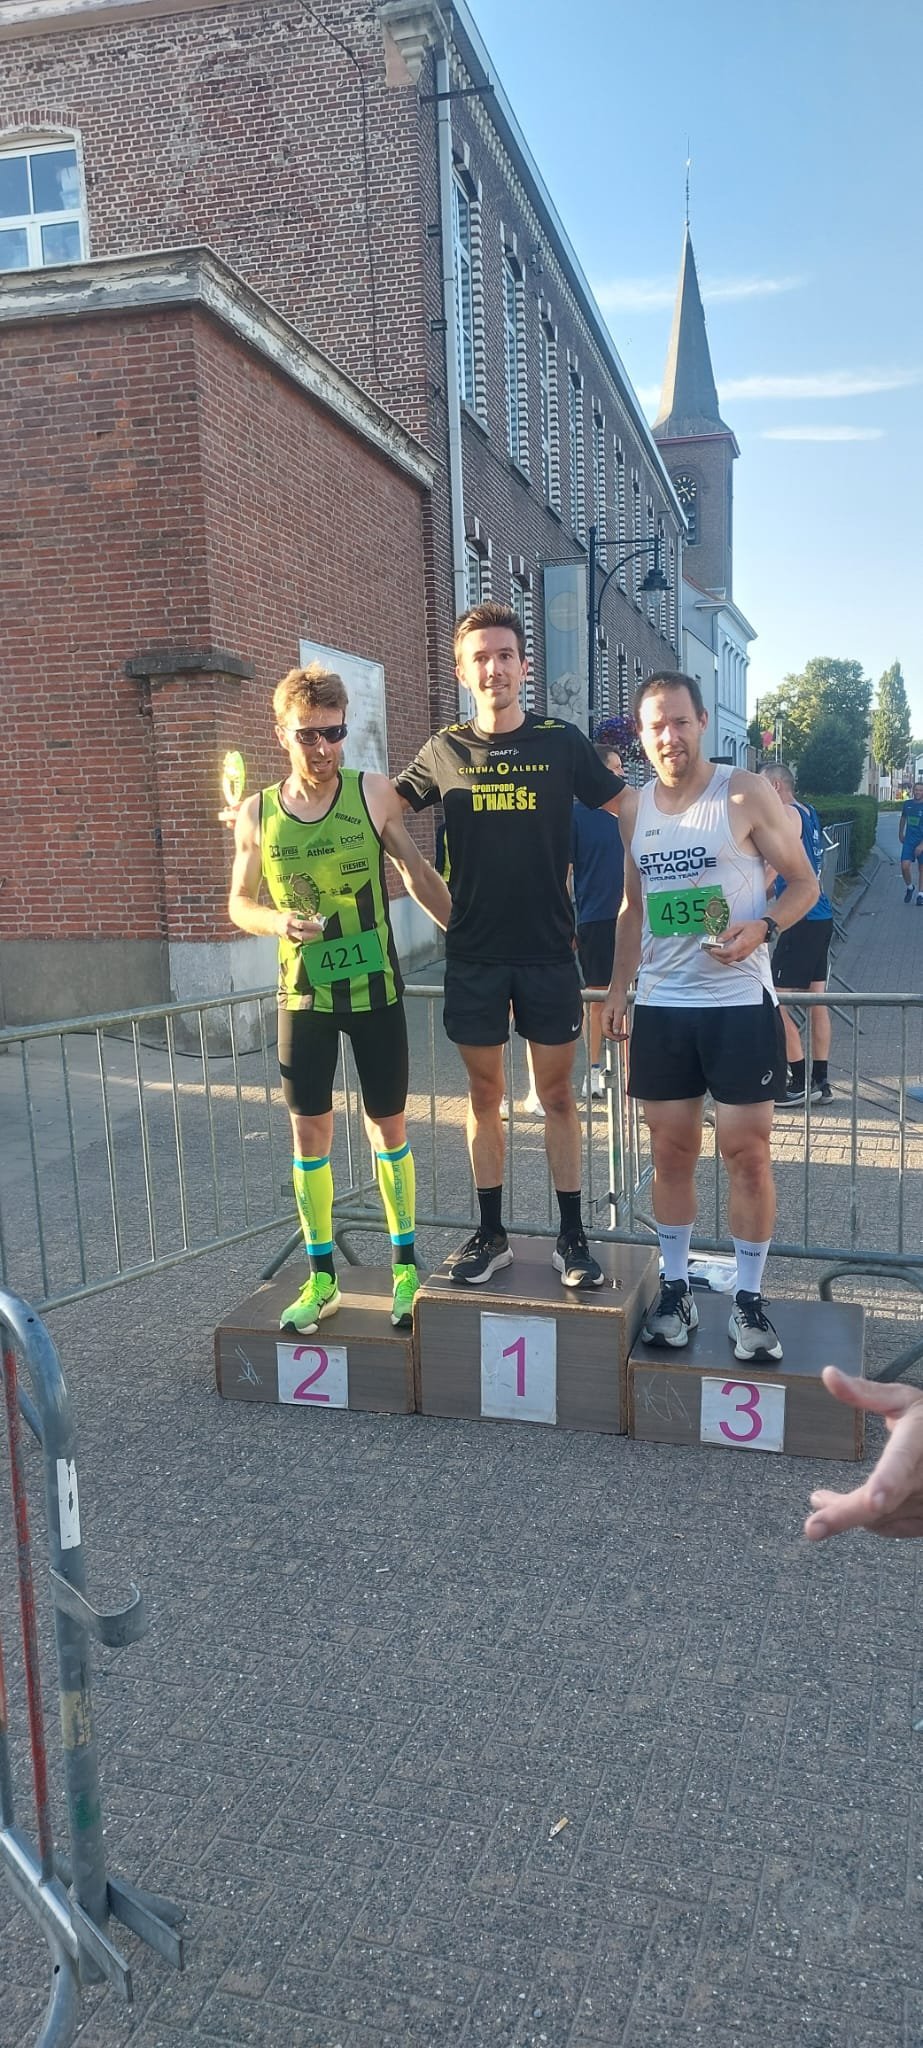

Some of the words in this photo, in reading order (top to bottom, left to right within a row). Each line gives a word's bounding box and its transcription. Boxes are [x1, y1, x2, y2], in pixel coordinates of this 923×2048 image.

[489, 749, 513, 757] CRAFT
[458, 765, 495, 775] CINEMA
[511, 764, 550, 772] ALBERT
[471, 782, 515, 793] SPORTPODO
[306, 846, 336, 858] Athlex
[640, 847, 706, 865] STUDIO
[649, 874, 676, 882] CYCLING
[677, 871, 699, 880] TEAM
[660, 899, 706, 926] 435
[320, 943, 368, 971] 421
[292, 1345, 331, 1403] 2
[502, 1336, 526, 1397] 1
[719, 1380, 763, 1442] 3
